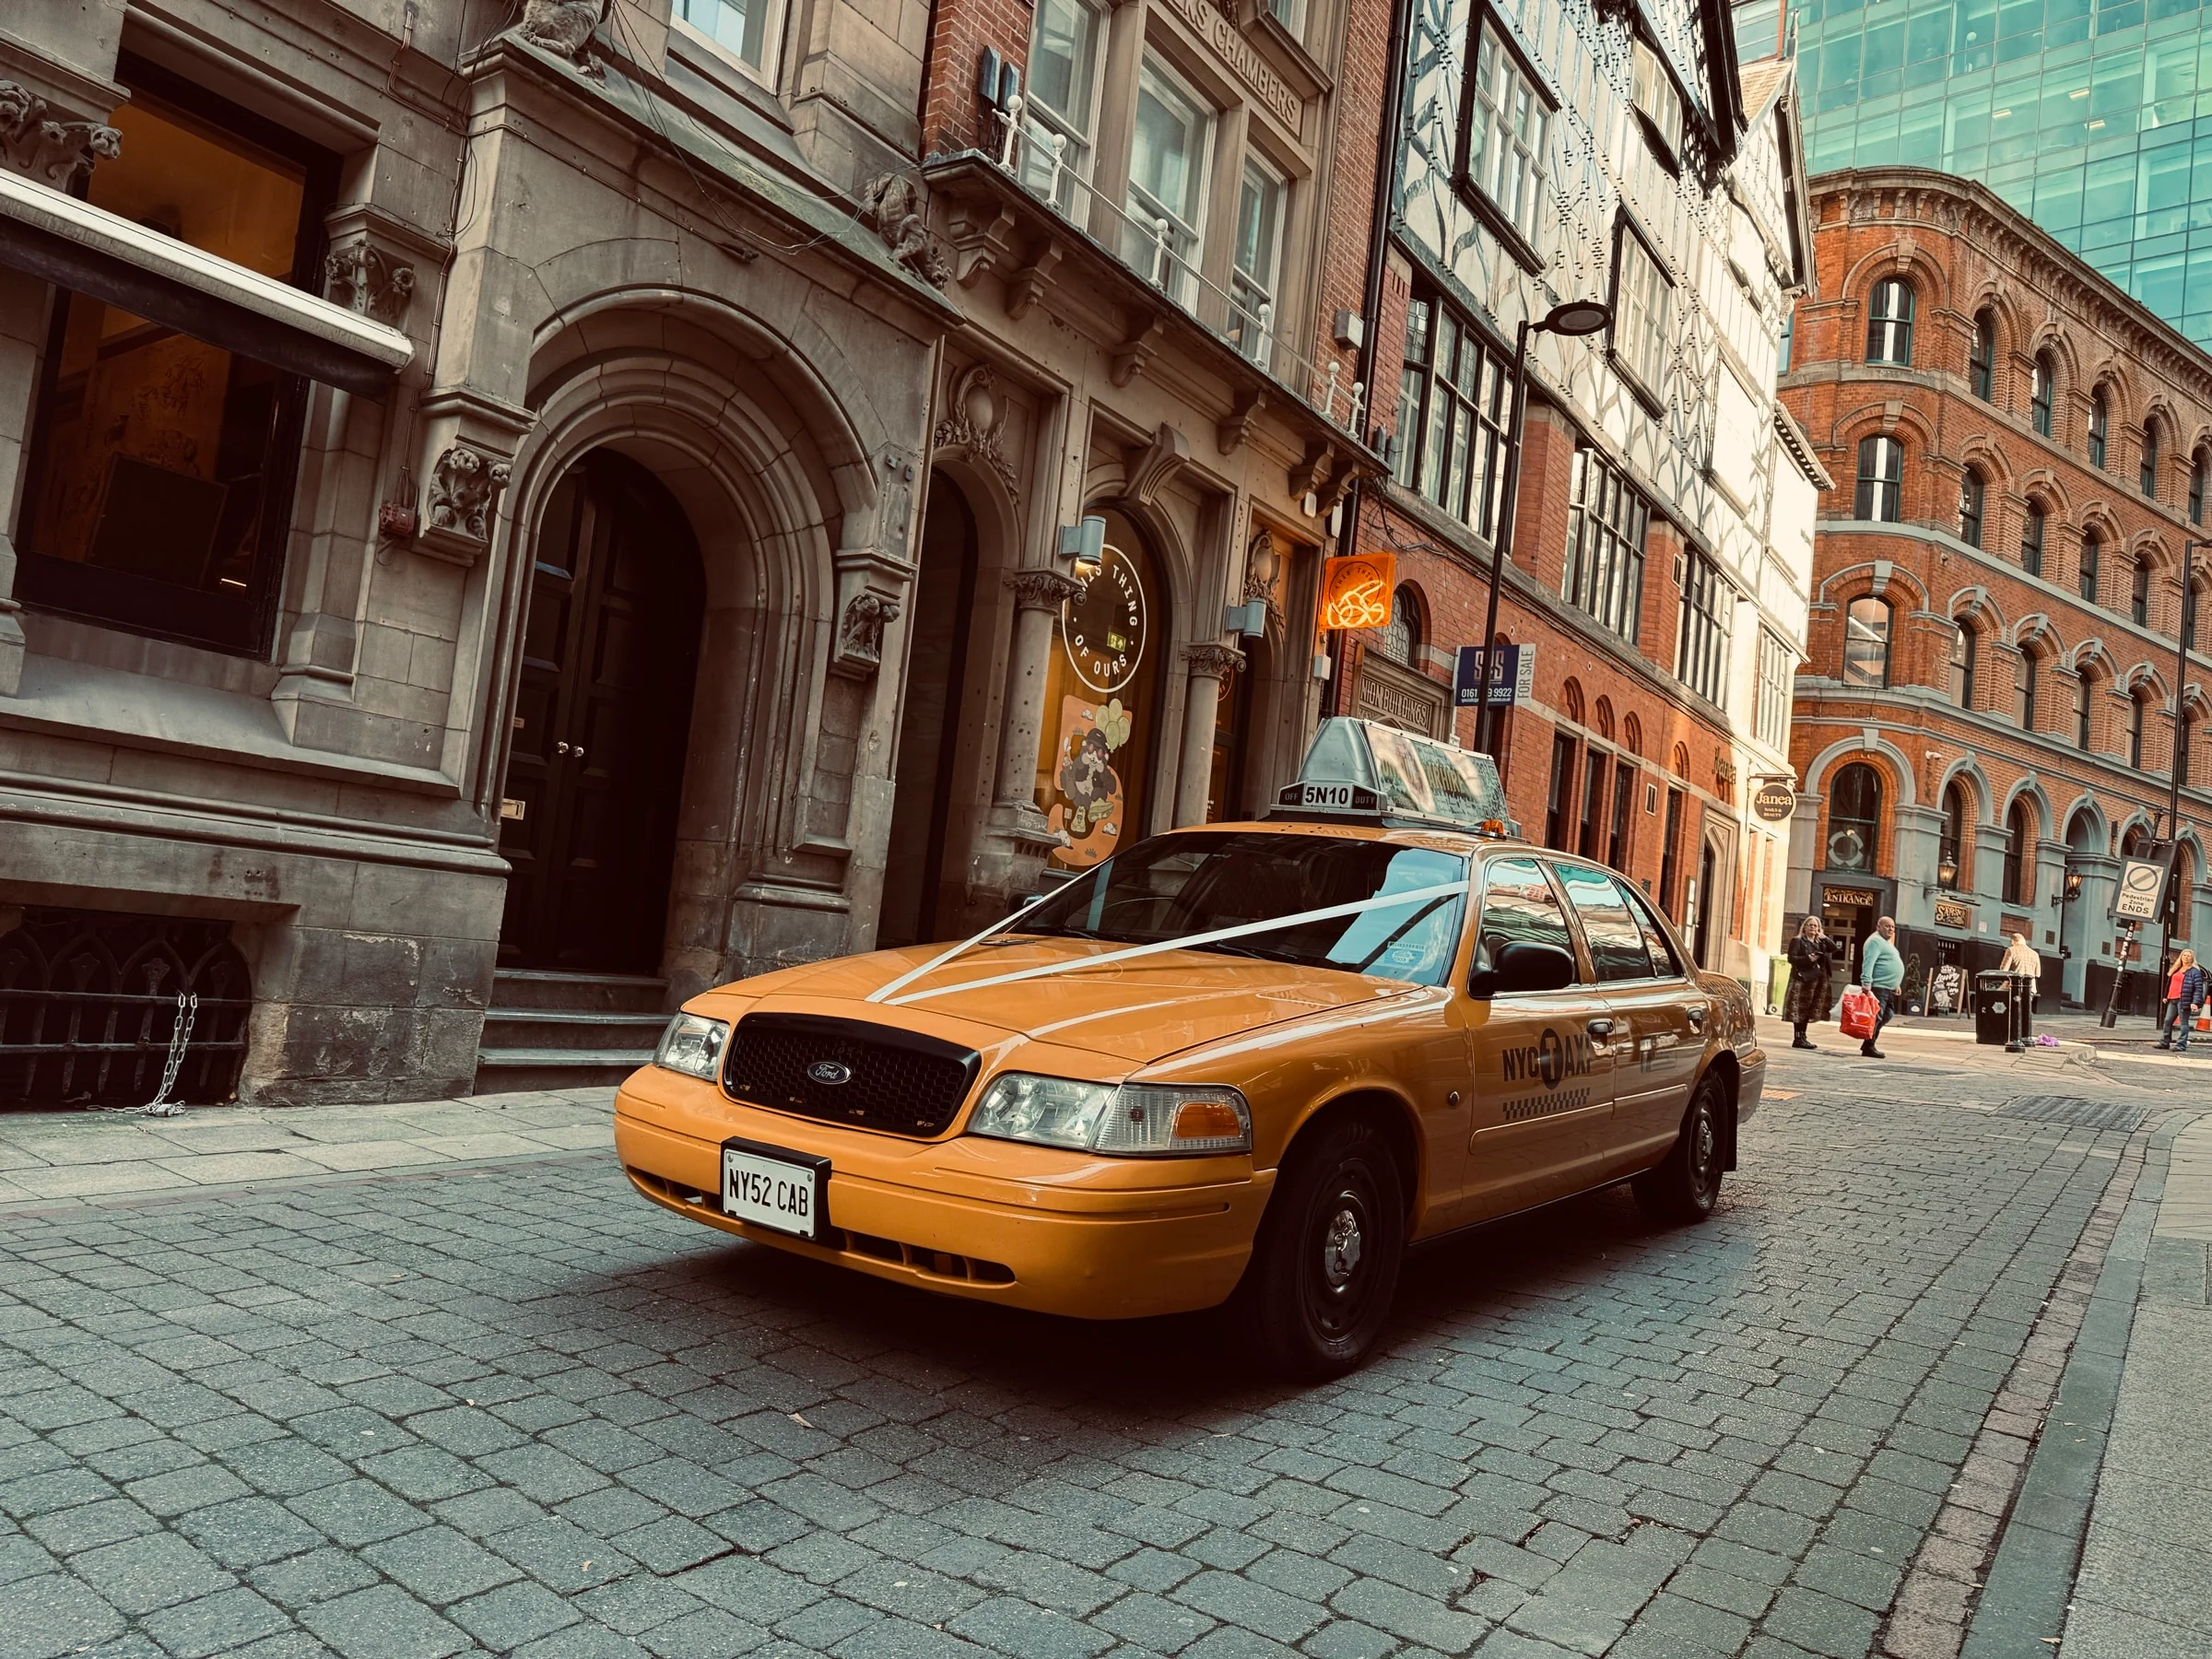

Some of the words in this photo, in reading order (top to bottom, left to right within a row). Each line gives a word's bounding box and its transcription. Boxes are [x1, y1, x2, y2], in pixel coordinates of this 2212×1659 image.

[1213, 18, 1297, 124] CHAMBERS
[1112, 564, 1138, 627] THING
[1075, 634, 1089, 658] OF
[1093, 653, 1127, 677] OURS
[1519, 650, 1534, 677] SALE
[1461, 688, 1478, 698] 0161
[1493, 688, 1512, 697] 9922
[1517, 679, 1531, 699] FOR
[1383, 688, 1428, 726] BUILDINGS
[1285, 793, 1299, 801] OFF
[1304, 786, 1349, 805] 5N10
[1355, 795, 1375, 805] DUTY
[1756, 793, 1793, 806] Janea
[1827, 892, 1871, 906] ENTRANCE
[2122, 892, 2155, 903] Pedestrian
[2122, 903, 2149, 914] ENDS
[815, 1064, 838, 1079] Ford
[1501, 1047, 1539, 1082] NYC
[729, 1168, 772, 1207] NY52
[777, 1181, 808, 1217] CAB
